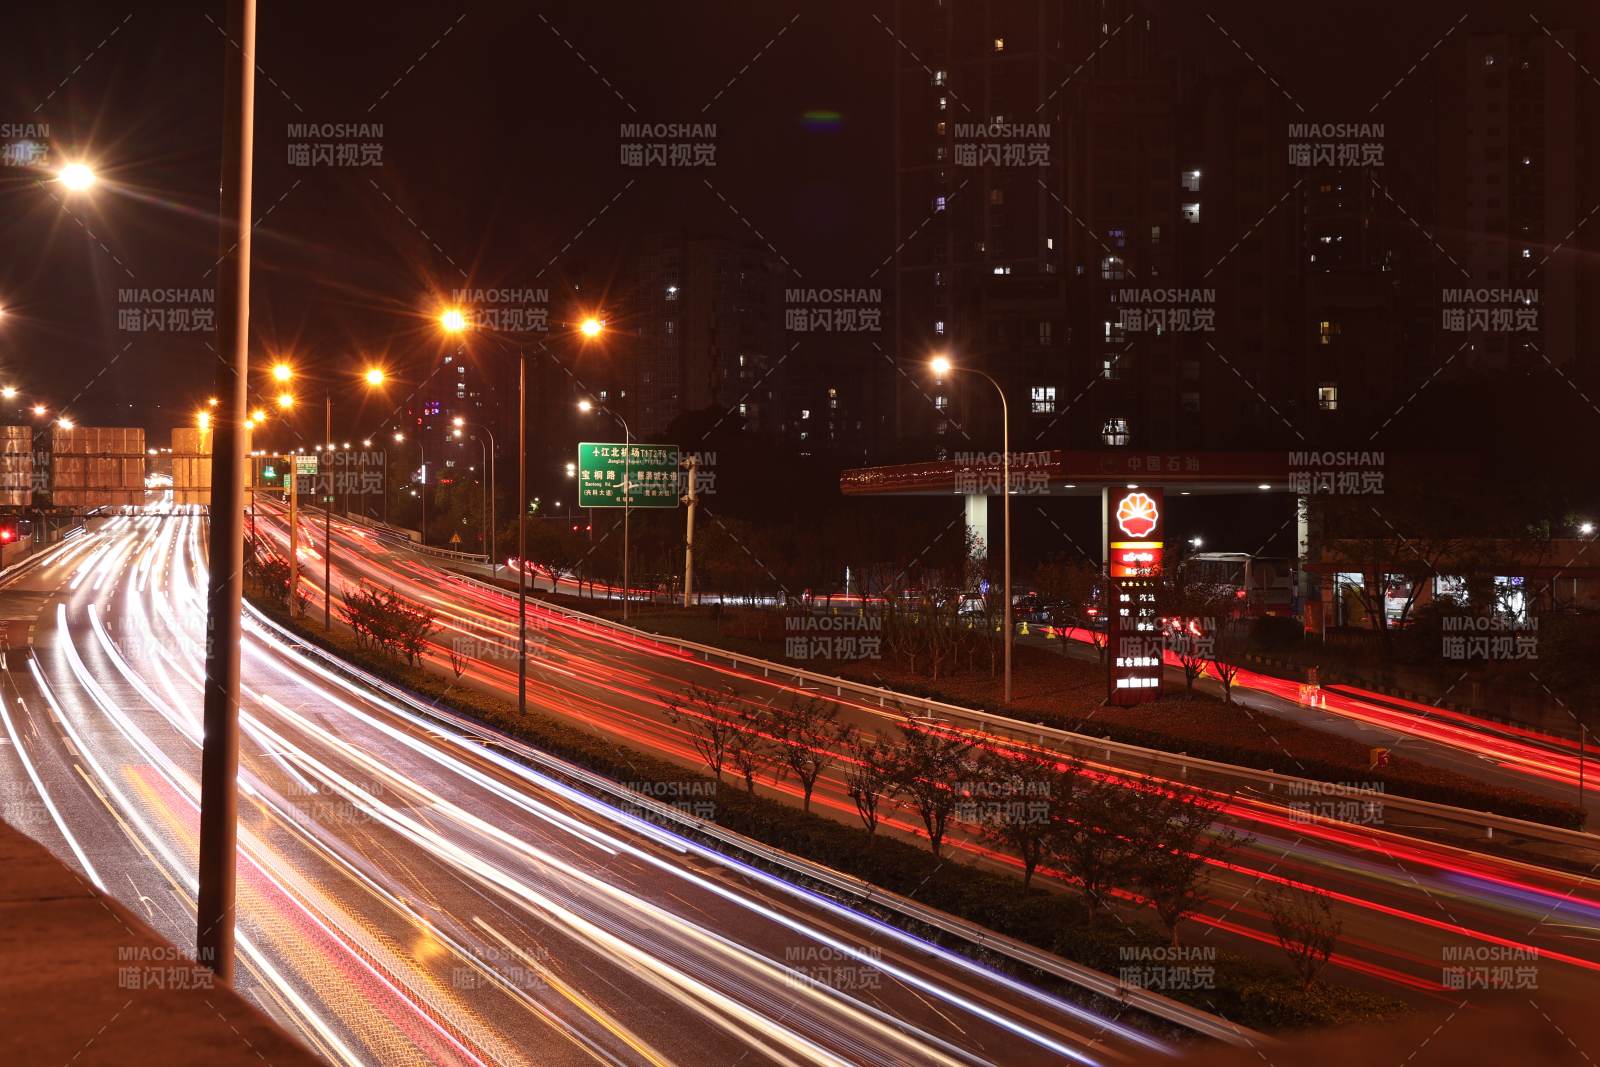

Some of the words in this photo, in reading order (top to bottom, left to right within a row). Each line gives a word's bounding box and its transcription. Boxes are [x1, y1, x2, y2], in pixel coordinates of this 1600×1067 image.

[1128, 455, 1200, 472] 中国石油
[1119, 608, 1130, 616] 92
